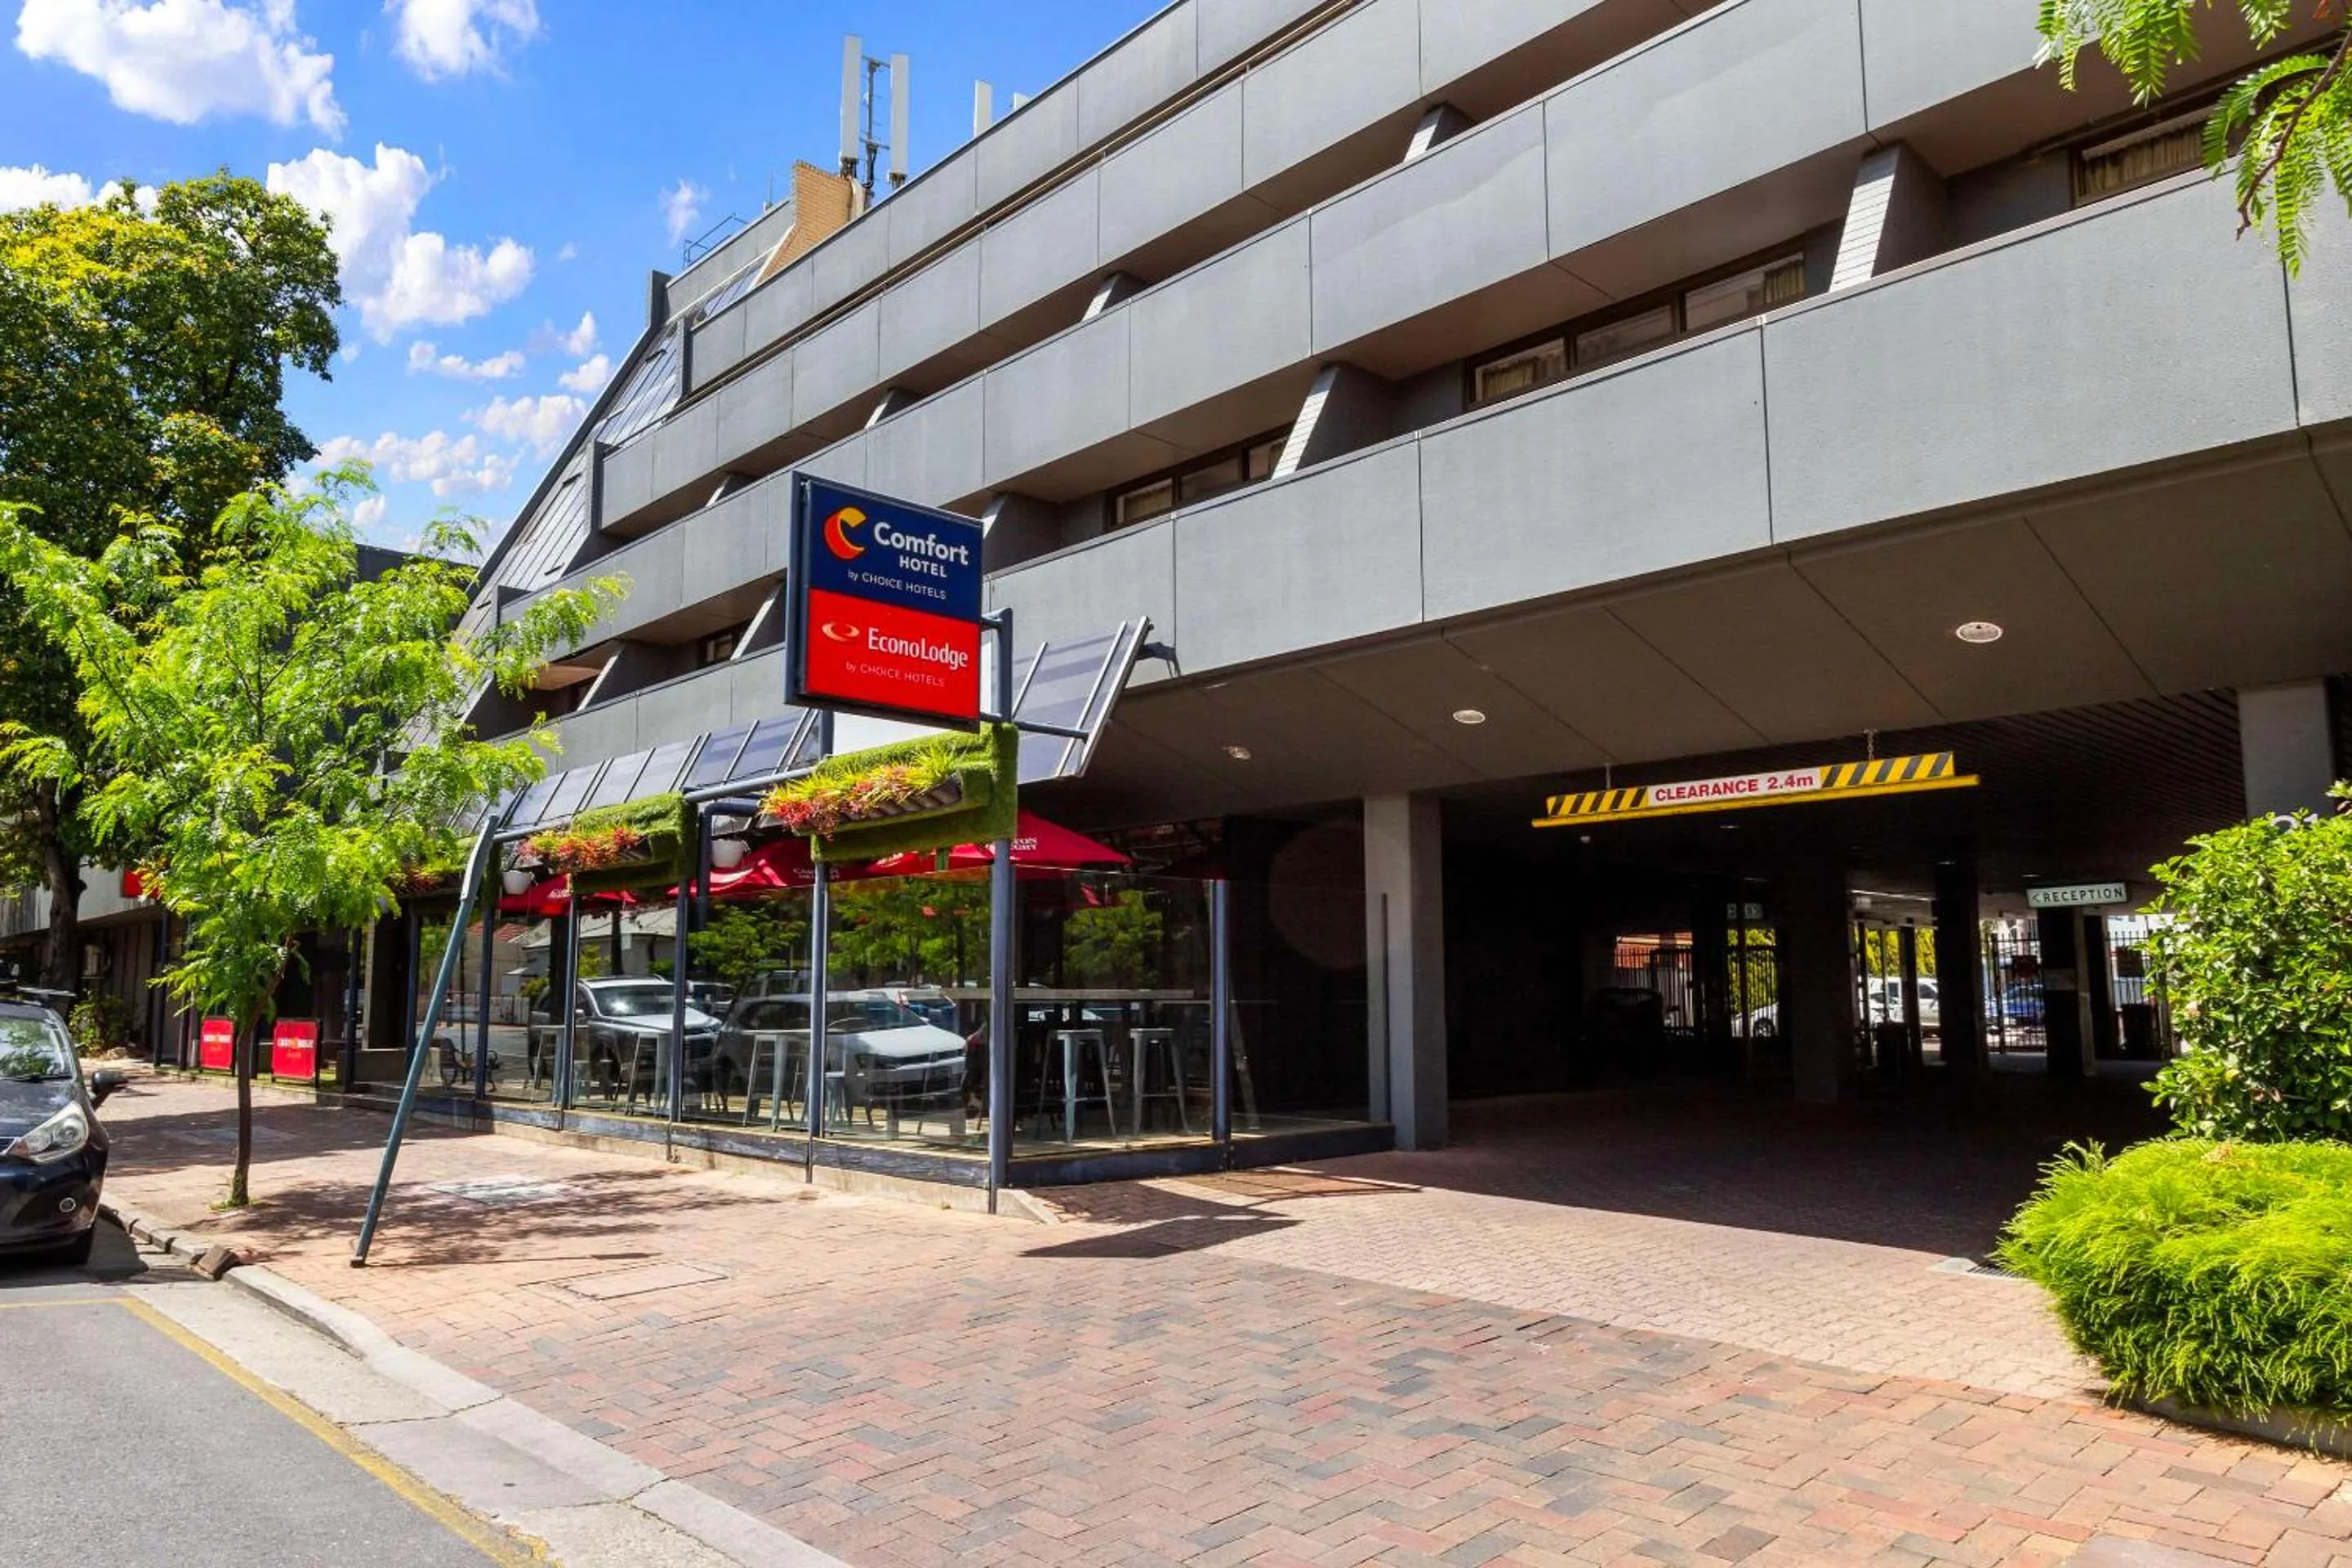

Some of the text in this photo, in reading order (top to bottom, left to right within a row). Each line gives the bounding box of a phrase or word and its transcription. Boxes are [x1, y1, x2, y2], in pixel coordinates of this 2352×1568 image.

[874, 522, 969, 565] Comfort
[899, 556, 947, 578] HOTEL
[848, 569, 947, 600] by CHOICE HOTELS
[868, 628, 968, 670] EconoLodge
[845, 662, 946, 688] by CHOICE HOTELS
[1655, 774, 1813, 801] CLEARANCE 2.4m
[2043, 888, 2123, 902] RECEPTION
